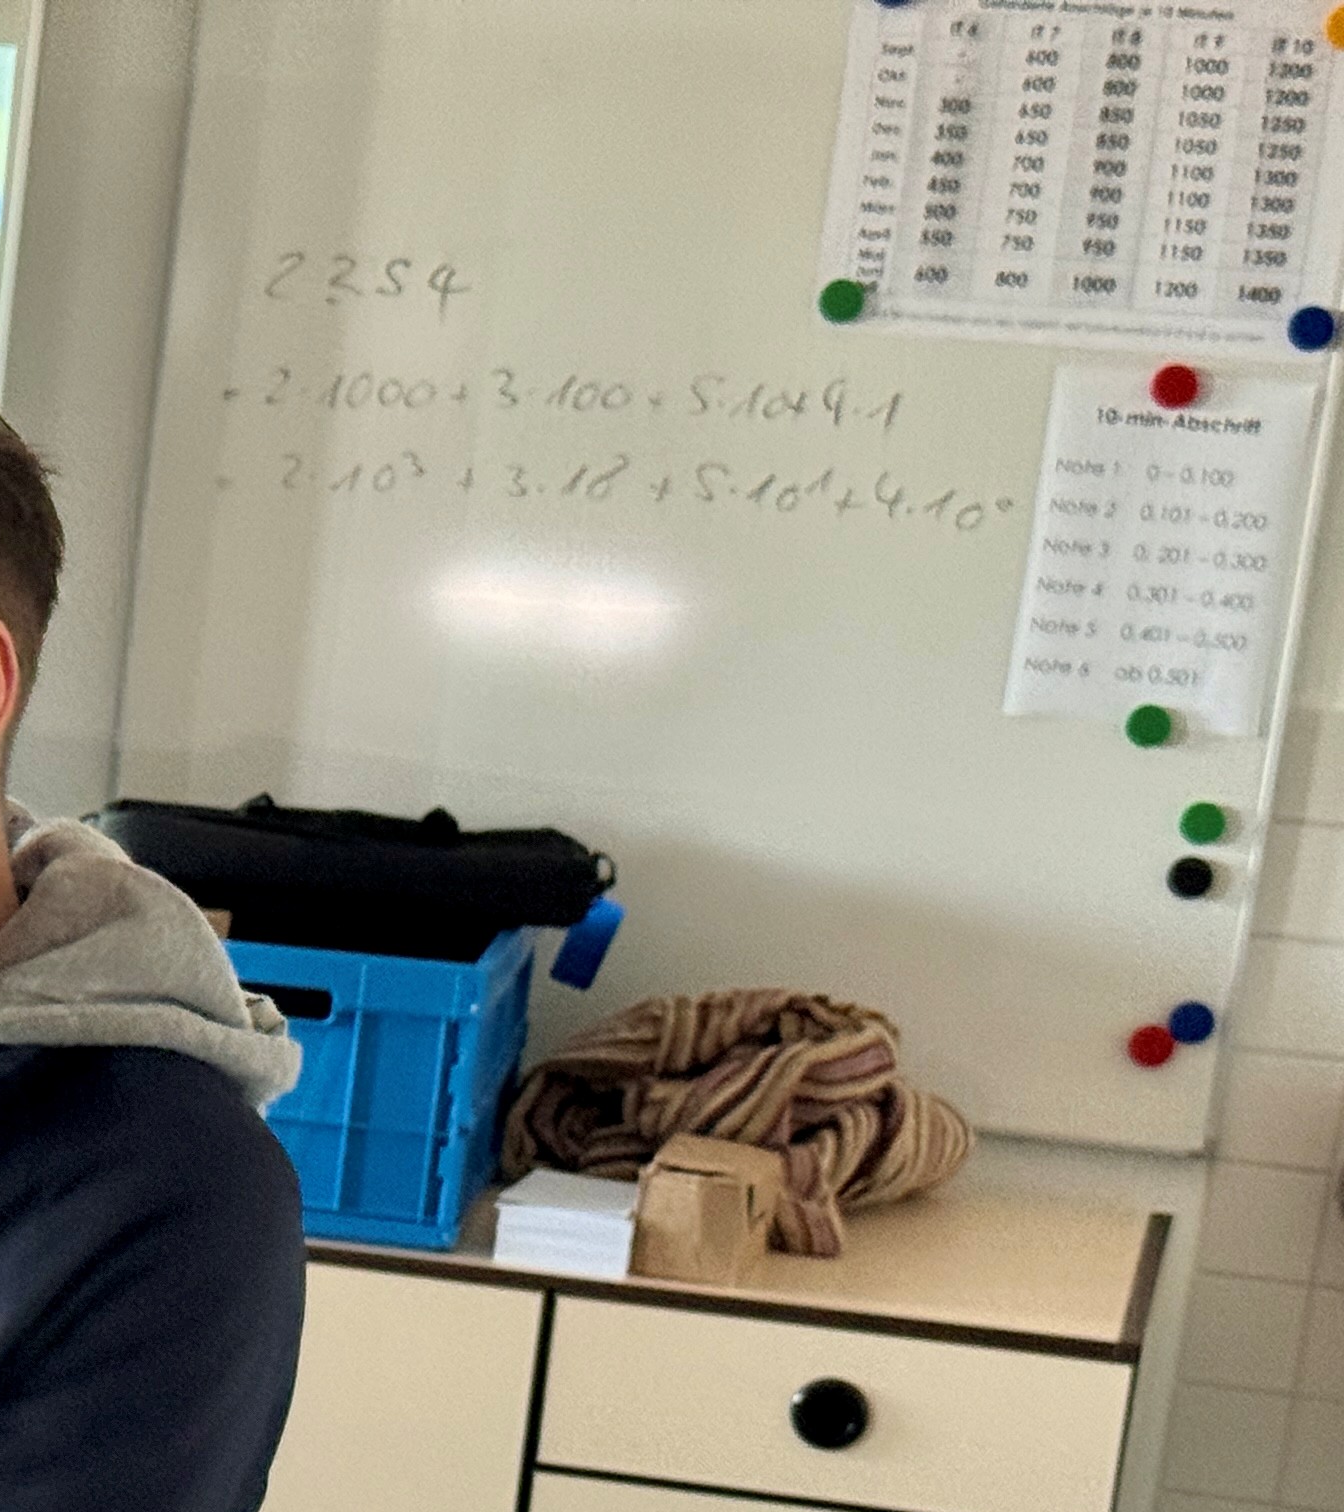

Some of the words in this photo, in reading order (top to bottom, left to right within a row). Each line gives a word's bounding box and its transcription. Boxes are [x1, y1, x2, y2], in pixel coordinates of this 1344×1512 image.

[1055, 458, 1105, 477] Note
[1049, 498, 1099, 516] Note
[1043, 537, 1092, 558] Note
[1036, 576, 1086, 597] Note
[1030, 616, 1080, 637] Note
[1024, 656, 1072, 676] Note
[1114, 664, 1143, 683] ab
